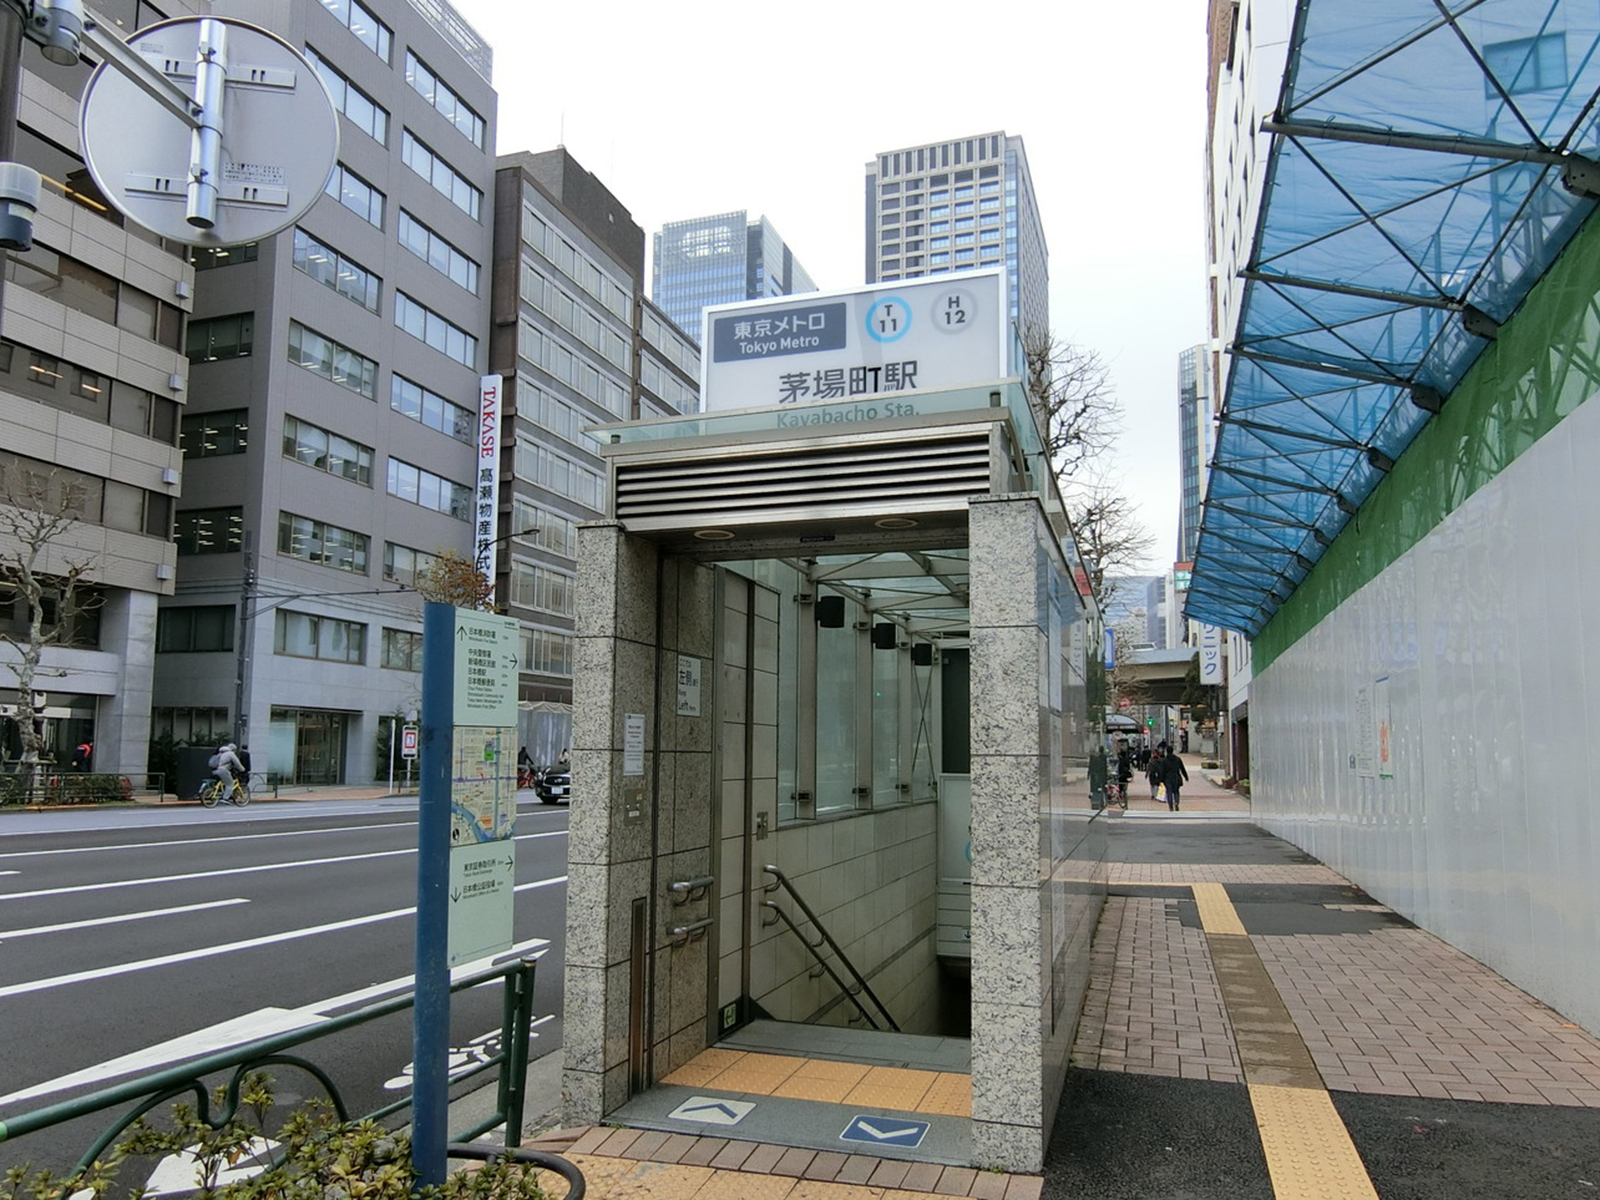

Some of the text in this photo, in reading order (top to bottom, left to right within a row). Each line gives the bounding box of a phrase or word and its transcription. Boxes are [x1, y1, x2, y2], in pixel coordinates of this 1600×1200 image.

[884, 304, 893, 317] T
[948, 295, 960, 309] H
[733, 312, 825, 340] 東京メトロ
[879, 318, 897, 333] 11
[945, 309, 966, 325] 12
[739, 336, 819, 355] Tokyo Metro
[779, 360, 917, 404] 茅場町駅
[481, 386, 496, 459] TAKASE
[777, 402, 920, 428] Kayabacho Sta.
